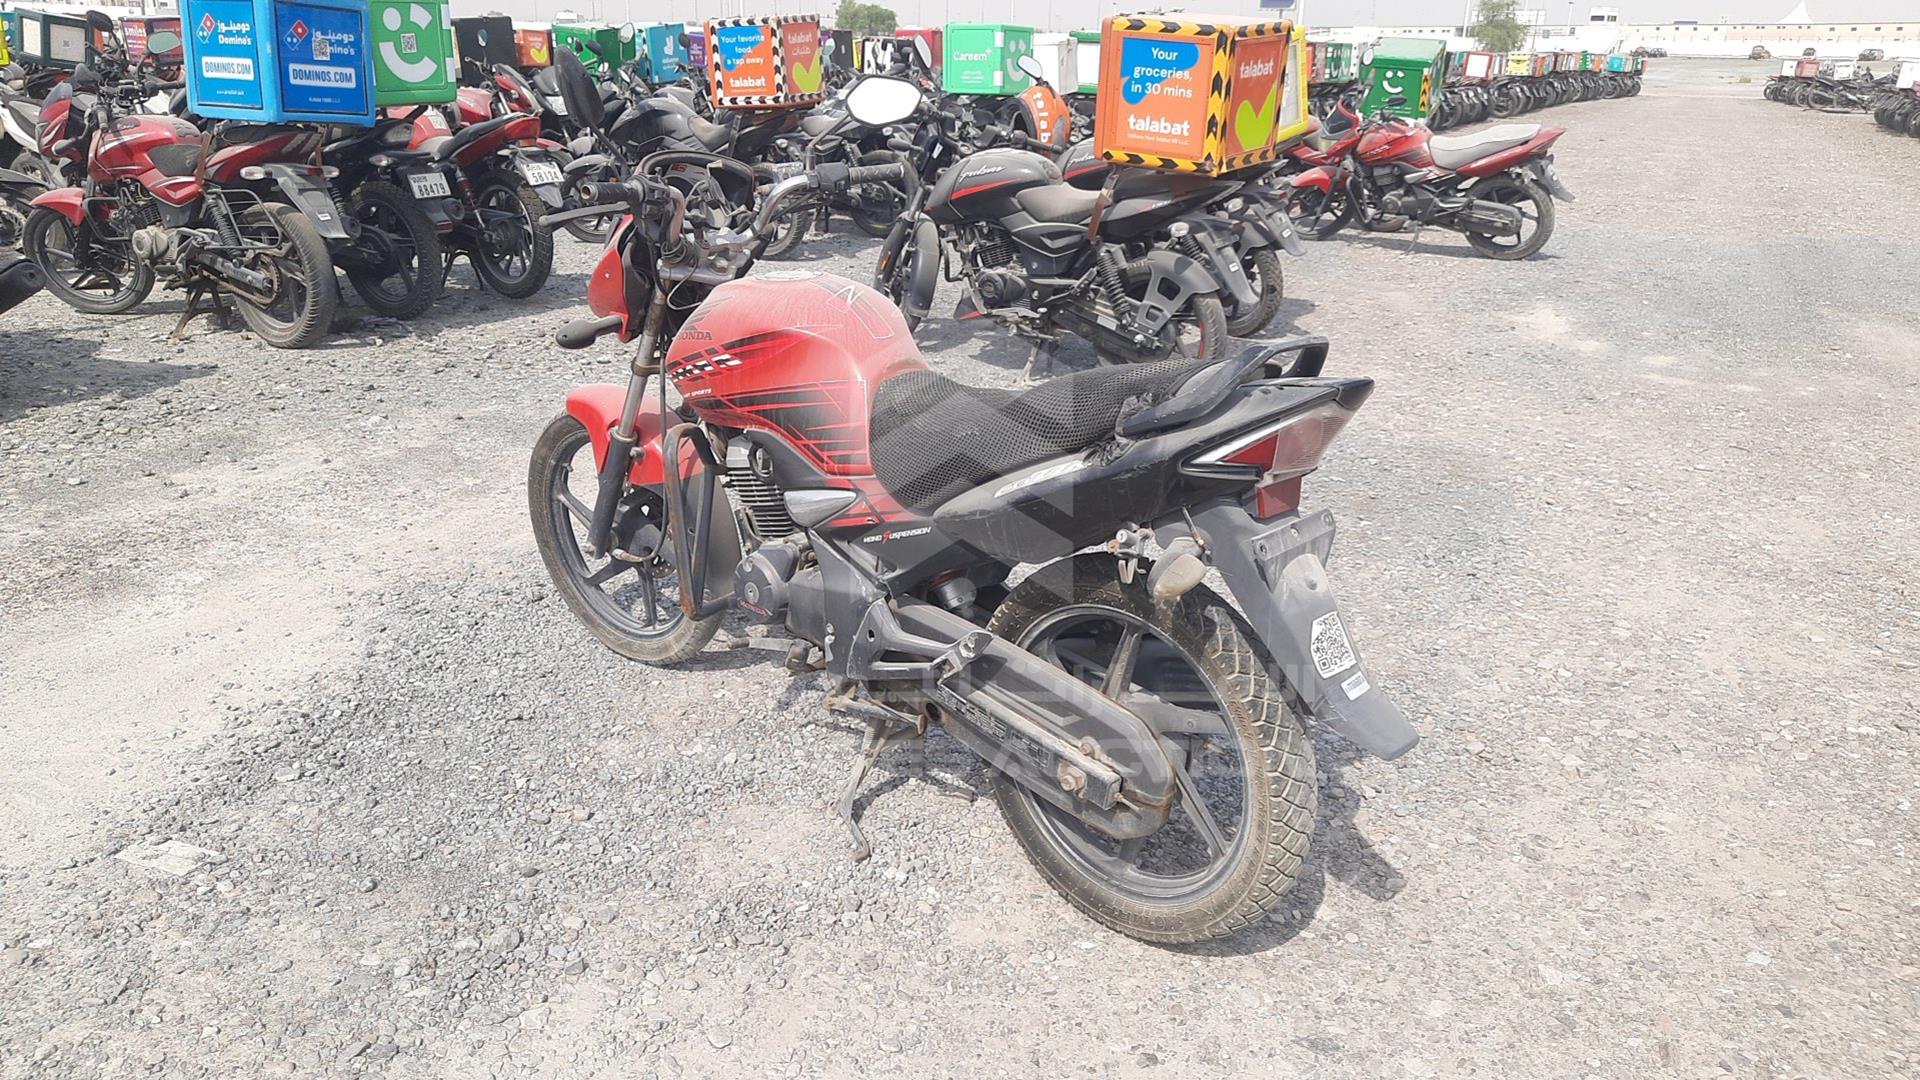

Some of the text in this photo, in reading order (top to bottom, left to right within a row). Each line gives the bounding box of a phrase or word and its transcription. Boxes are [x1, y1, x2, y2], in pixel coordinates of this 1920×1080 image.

[1151, 47, 1178, 60] Your
[204, 61, 252, 75] DOMINOS.COM
[1133, 66, 1193, 82] groceries,
[1240, 58, 1274, 78] talabat
[292, 70, 353, 84] DOMINOS.COM
[729, 76, 766, 88] talabat
[1131, 81, 1193, 98] in 30 mins
[1127, 114, 1190, 136] talabat
[418, 182, 446, 197] 88479
